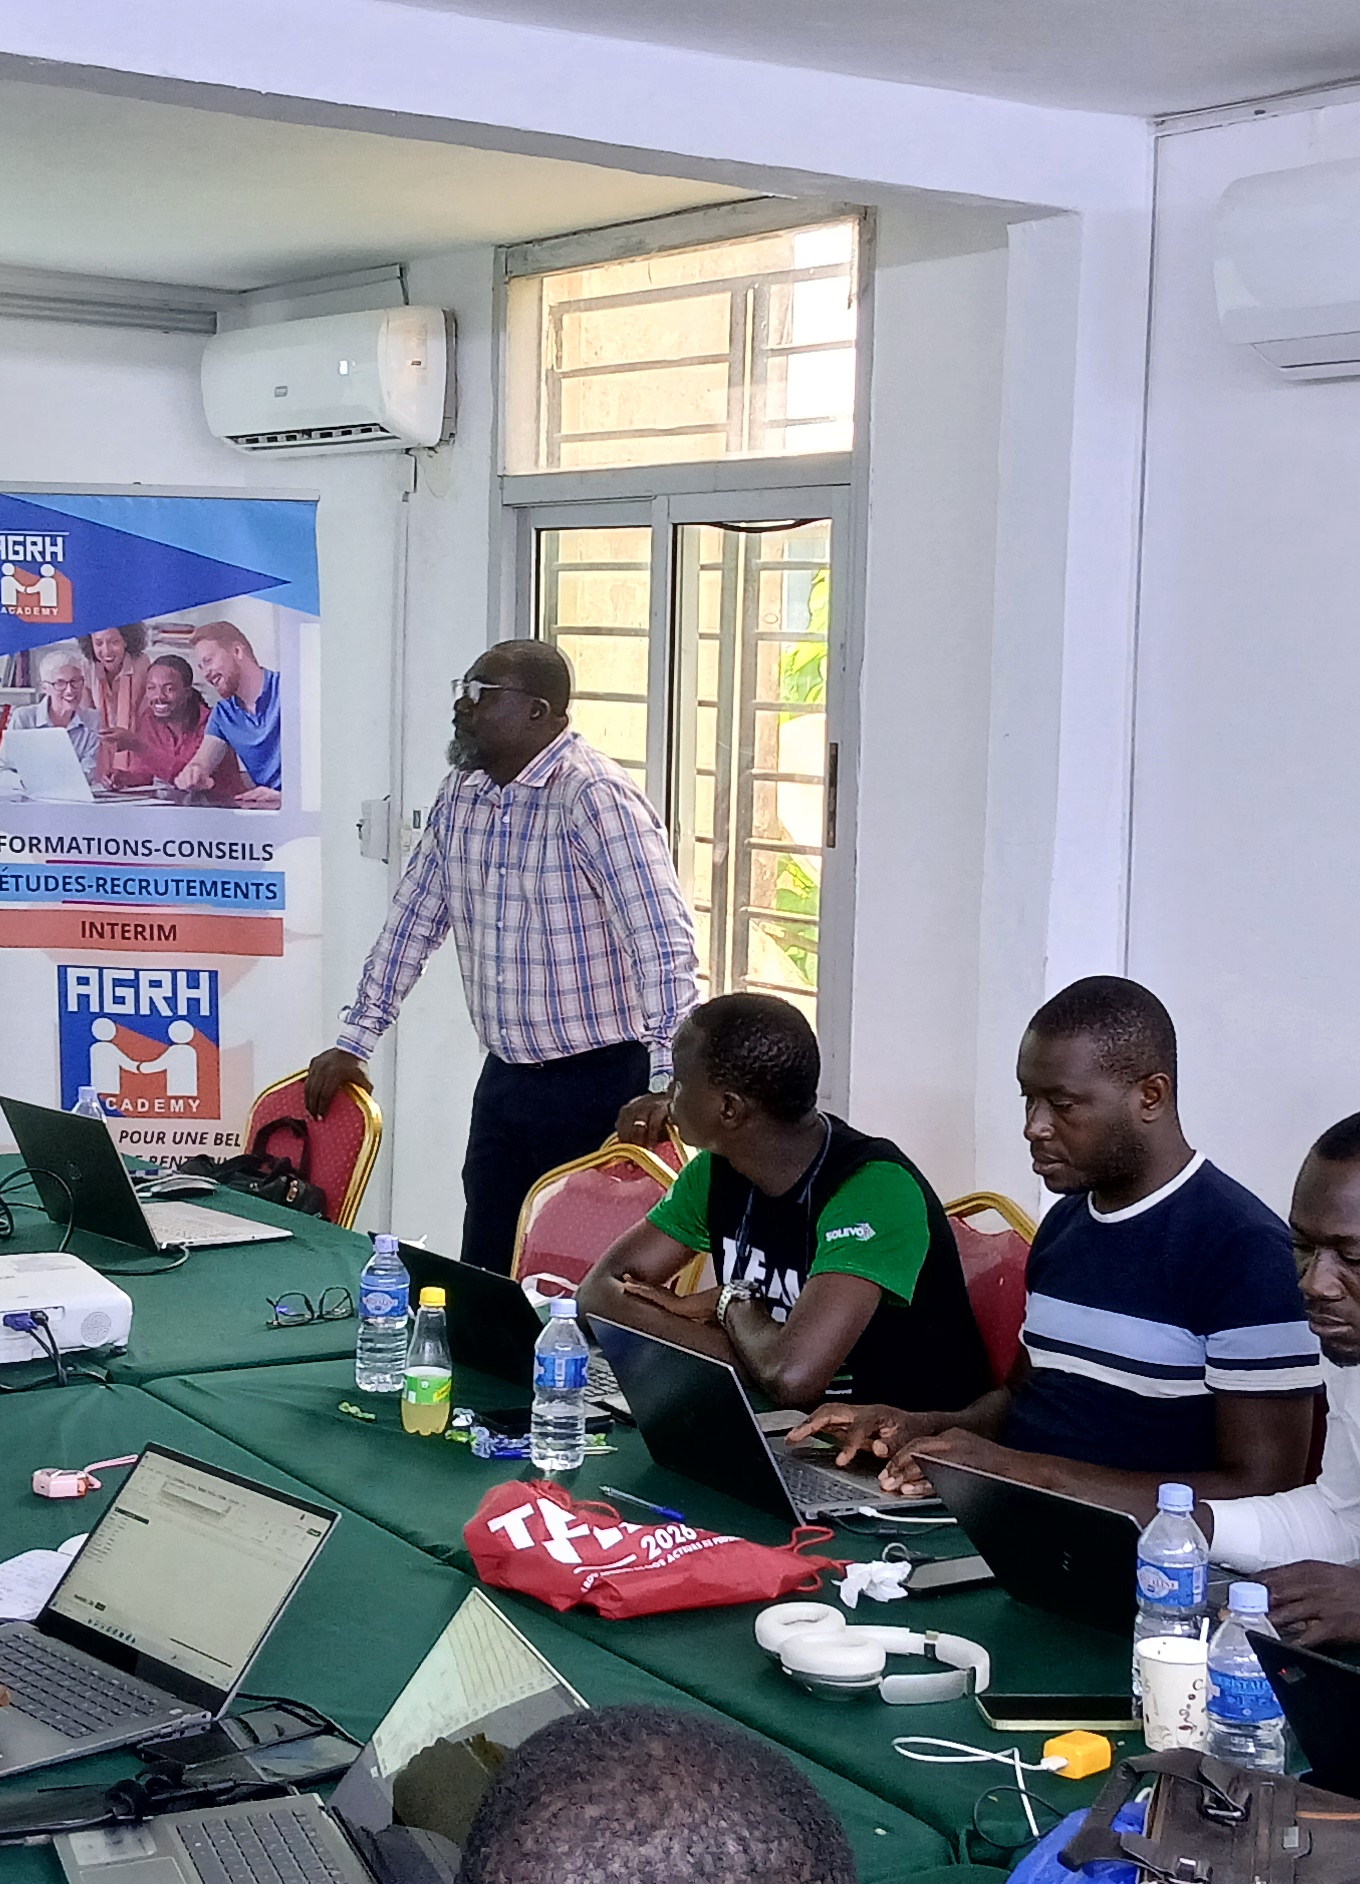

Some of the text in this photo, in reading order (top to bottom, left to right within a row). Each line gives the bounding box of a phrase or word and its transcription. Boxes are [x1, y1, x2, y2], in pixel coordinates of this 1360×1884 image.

[0, 606, 59, 616] ACADEMY
[79, 920, 178, 943] INTERIM
[67, 967, 211, 1016] AGRH
[104, 1096, 201, 1113] CADEMY
[118, 1129, 166, 1145] POUR
[172, 1130, 209, 1146] UNE
[640, 1523, 698, 1561] 2026
